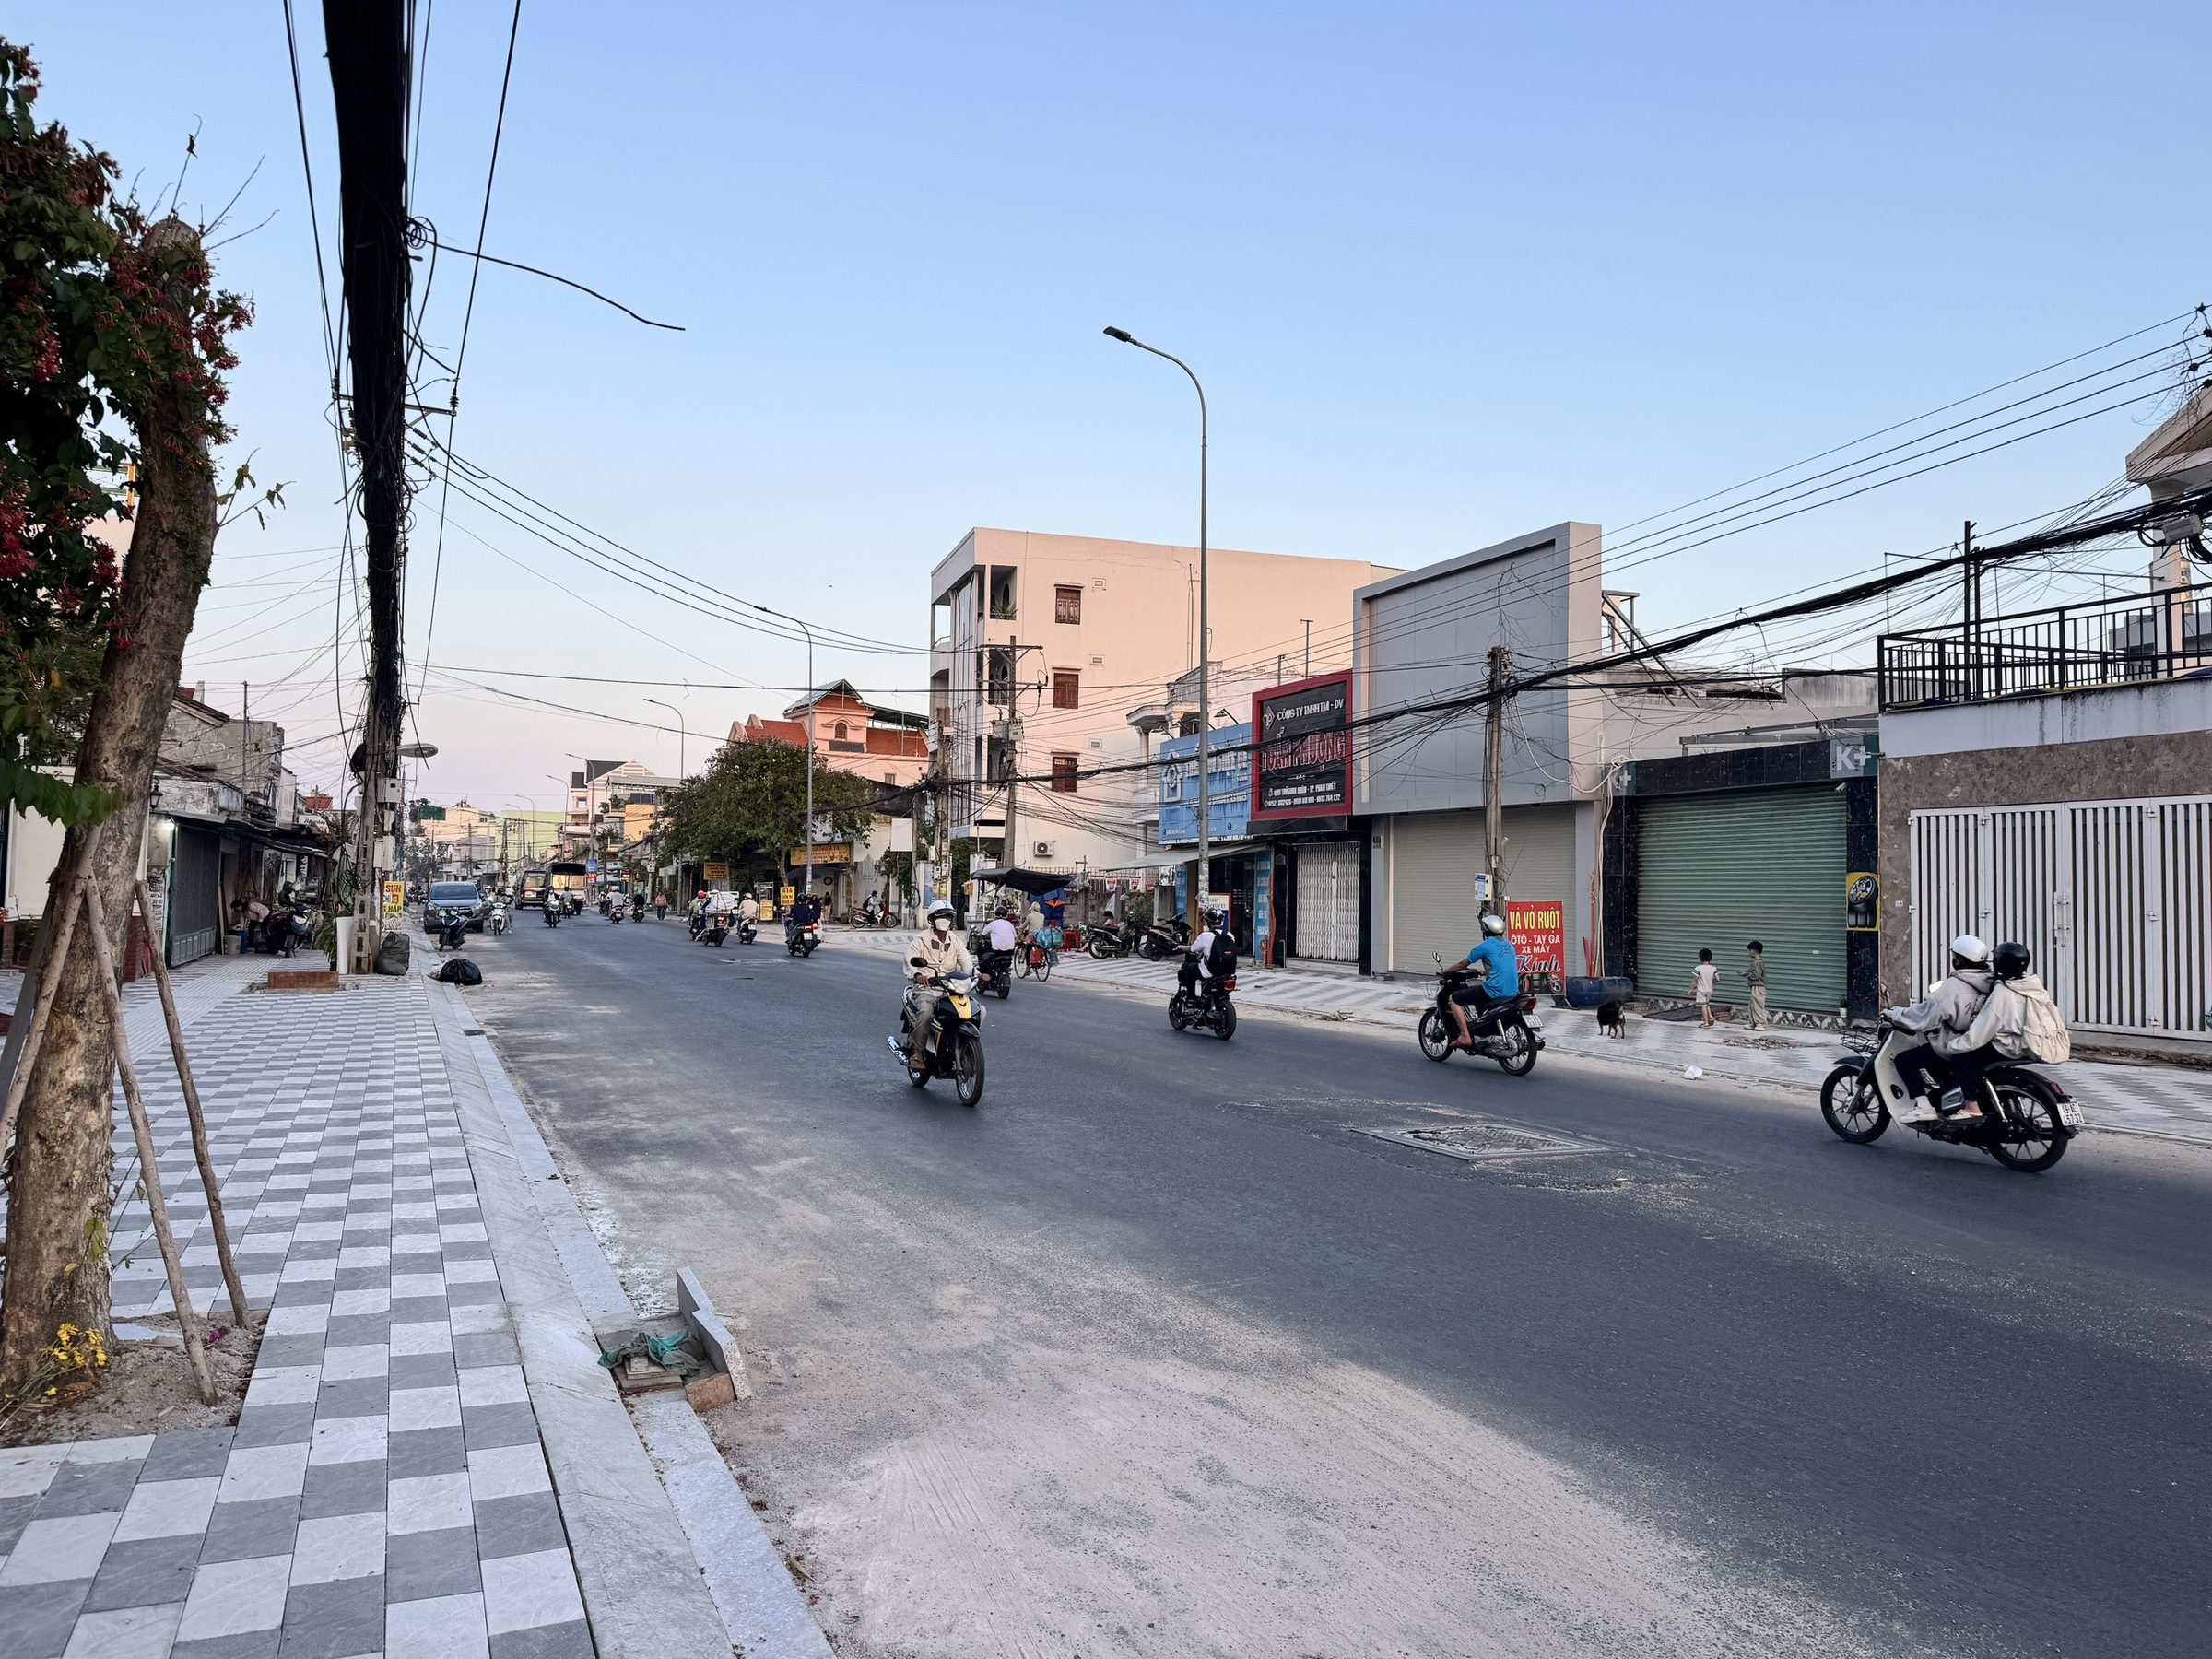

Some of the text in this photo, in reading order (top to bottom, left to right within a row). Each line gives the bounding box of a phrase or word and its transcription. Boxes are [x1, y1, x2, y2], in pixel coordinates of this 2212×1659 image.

[1277, 708, 1295, 721] CÔNG
[1296, 706, 1303, 718] TY
[1335, 698, 1345, 710] DV
[1509, 904, 1560, 934] VÁ VỎ RUỘT
[1511, 933, 1527, 945] ÔTÔ
[1533, 935, 1547, 945] TAY
[1548, 934, 1560, 944] GA
[1521, 943, 1550, 954] XE MÁY
